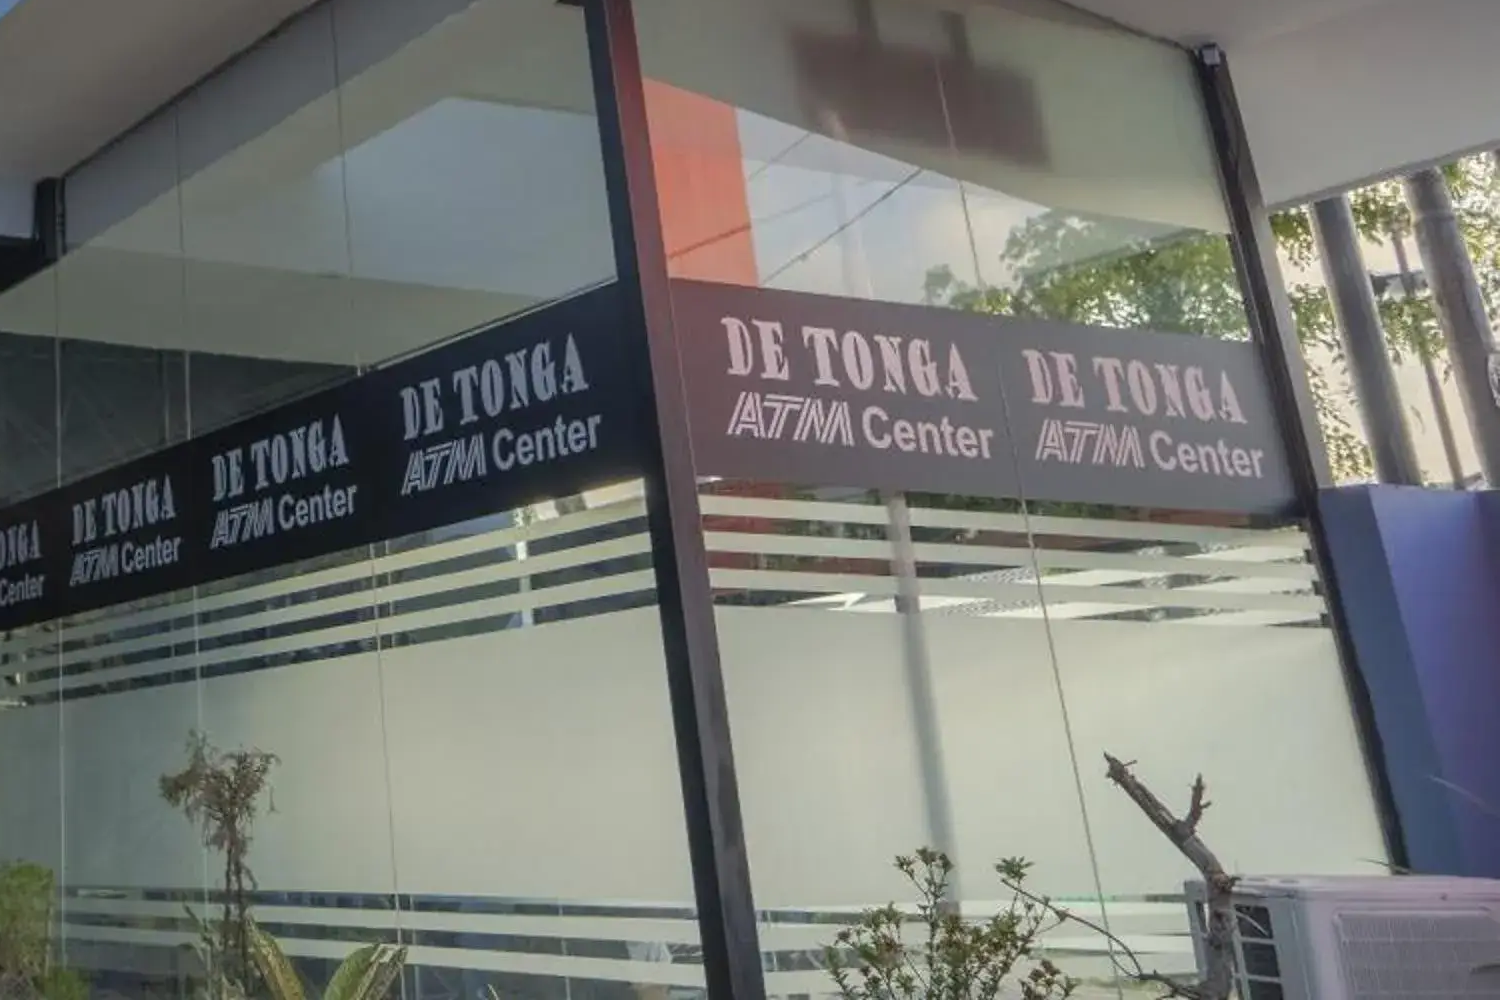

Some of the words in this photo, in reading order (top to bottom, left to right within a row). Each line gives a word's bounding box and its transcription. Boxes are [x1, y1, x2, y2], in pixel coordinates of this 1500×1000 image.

[400, 374, 445, 441] DE
[452, 332, 591, 427] TONGA
[721, 317, 790, 380] DE
[802, 326, 979, 401] TONGA
[1022, 348, 1084, 408] DE
[1090, 356, 1248, 425] TONGA
[211, 444, 245, 502] DE
[250, 412, 351, 492] TONGA
[400, 432, 488, 496] ATM
[491, 413, 602, 473] Center
[726, 391, 855, 447] ATM
[861, 405, 993, 461] Center
[1035, 419, 1145, 469] ATM
[1149, 432, 1264, 480] Center
[73, 499, 97, 544] DE
[102, 474, 176, 537] TONGA
[209, 496, 276, 550] ATM
[278, 484, 358, 532] Center
[69, 546, 119, 587] ATM
[121, 535, 181, 574] Center
